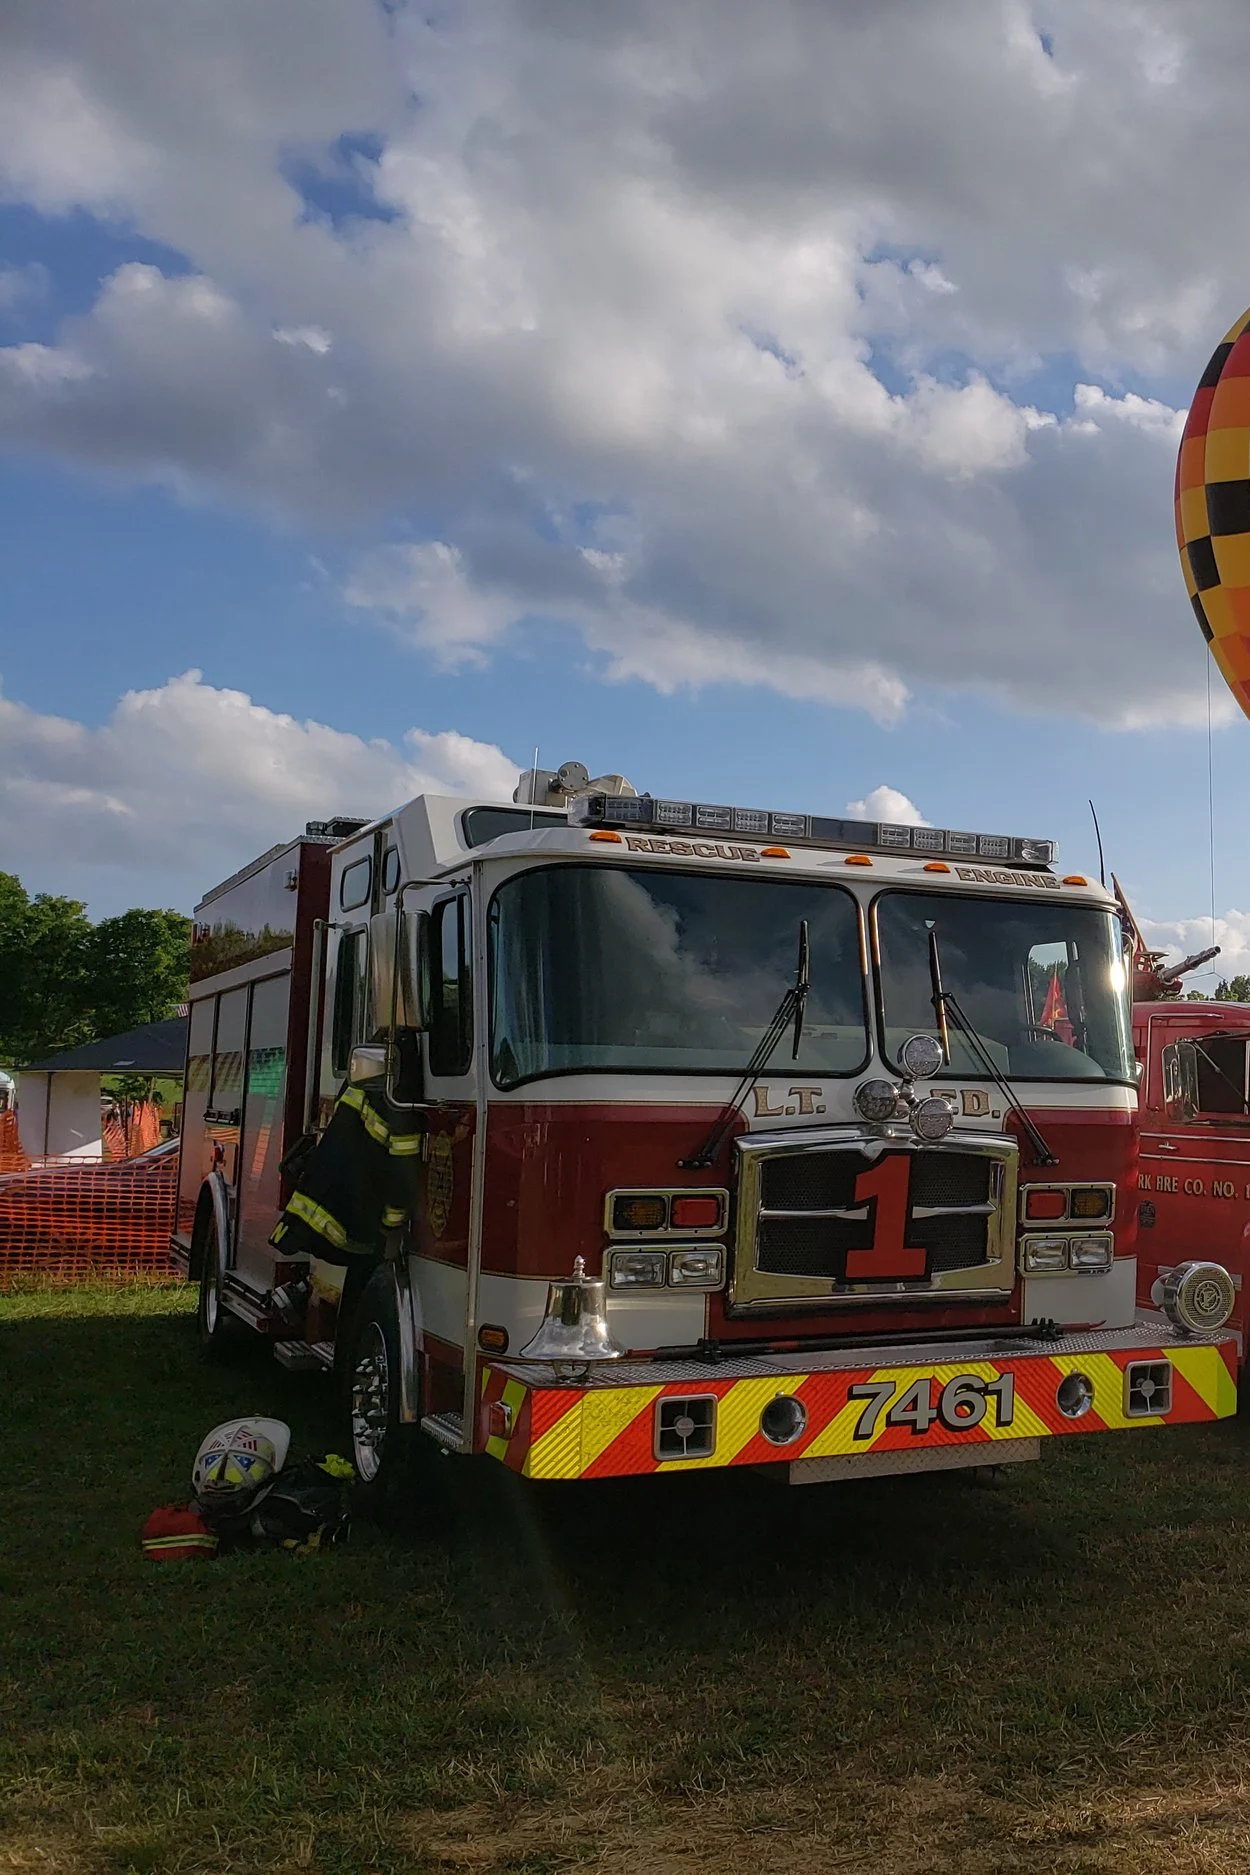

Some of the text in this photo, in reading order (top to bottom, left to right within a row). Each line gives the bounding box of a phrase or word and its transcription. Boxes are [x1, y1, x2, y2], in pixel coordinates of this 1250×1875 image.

[625, 837, 761, 862] RESCUE
[954, 867, 1061, 889] ENGINE
[753, 1086, 827, 1117] L.T.
[1156, 1175, 1179, 1193] FIRE
[1184, 1179, 1207, 1196] CO.
[1213, 1181, 1239, 1199] NO.
[1244, 1183, 1250, 1199] 1
[844, 1154, 928, 1279] 1
[848, 1372, 1015, 1441] 7461
